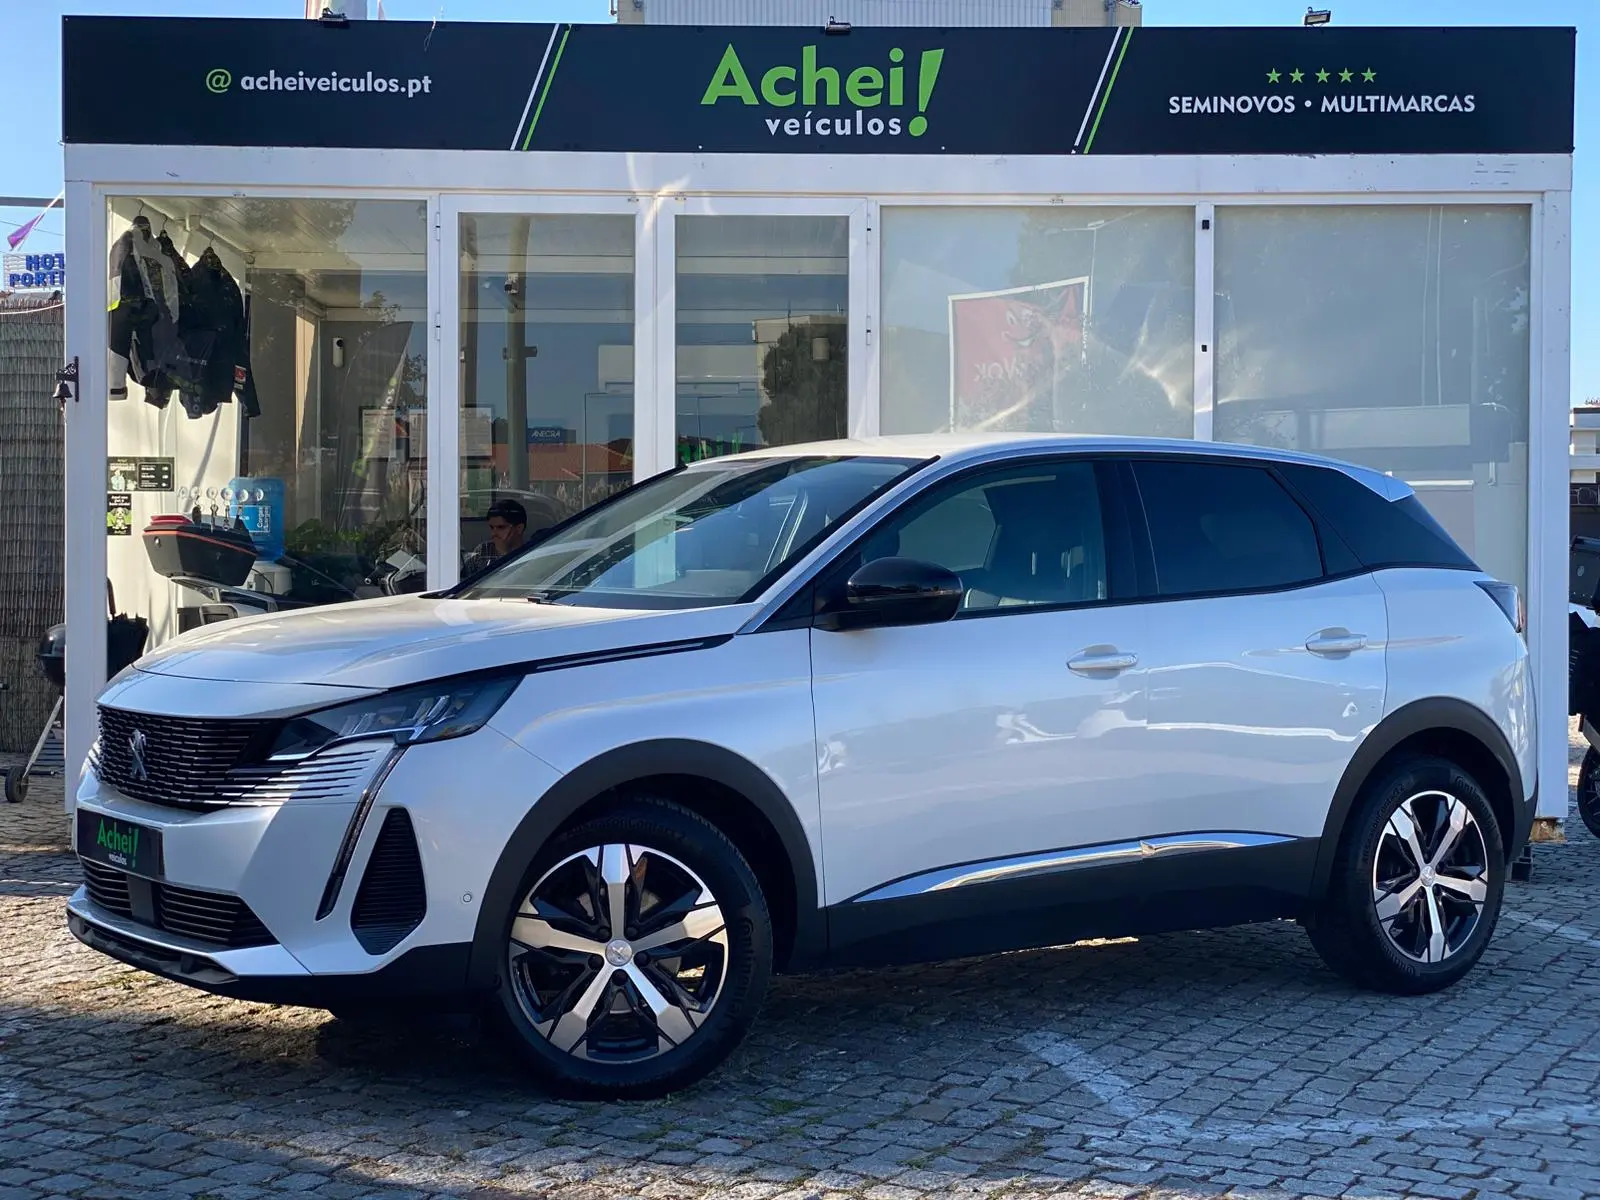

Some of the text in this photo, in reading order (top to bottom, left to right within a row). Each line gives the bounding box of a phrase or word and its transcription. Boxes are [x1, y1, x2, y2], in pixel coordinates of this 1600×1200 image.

[206, 68, 432, 98] @ acheiveiculos.pt
[700, 42, 945, 137] Achei!
[1169, 94, 1476, 114] SEMINOVOS MULTIMARCAS
[765, 109, 902, 136] veículos
[97, 817, 139, 868] Achei!
